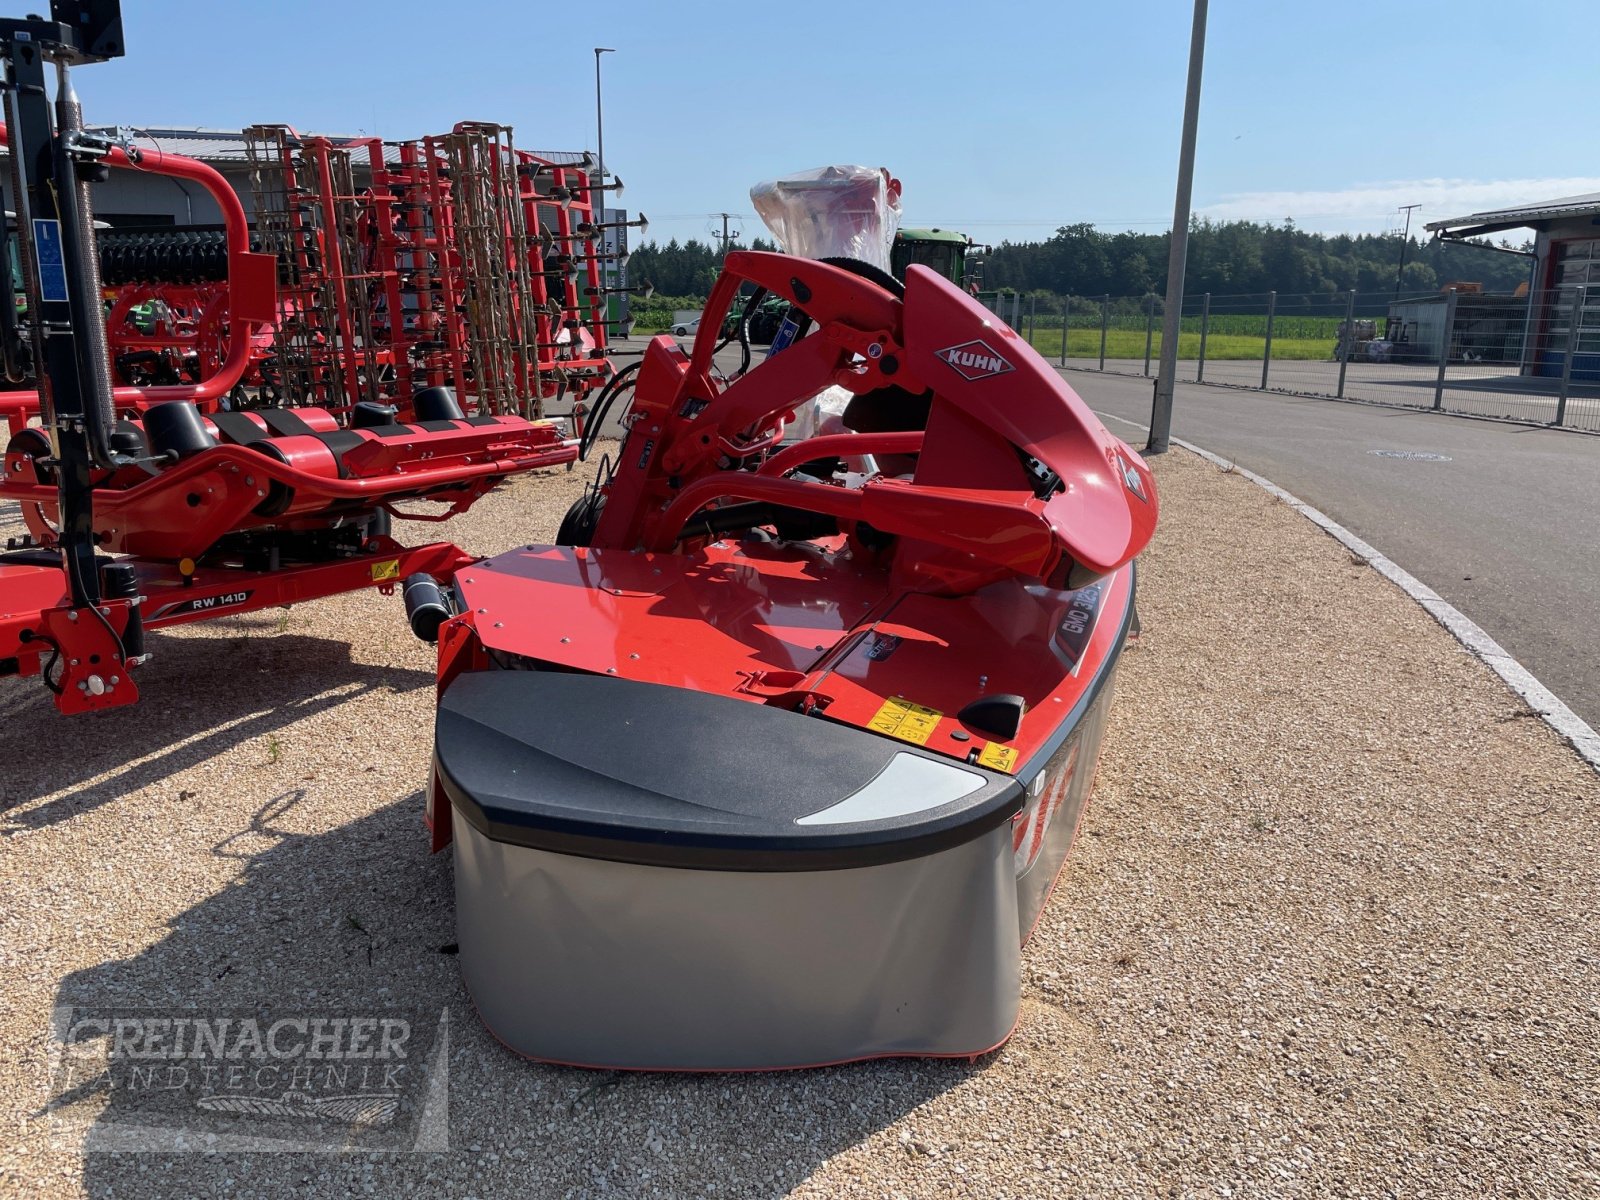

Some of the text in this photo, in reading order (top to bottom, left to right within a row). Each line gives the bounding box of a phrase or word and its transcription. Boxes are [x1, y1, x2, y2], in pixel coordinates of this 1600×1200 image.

[947, 349, 1002, 372] KUHN
[193, 592, 247, 609] RW 1410
[1062, 588, 1099, 634] GMD 3125
